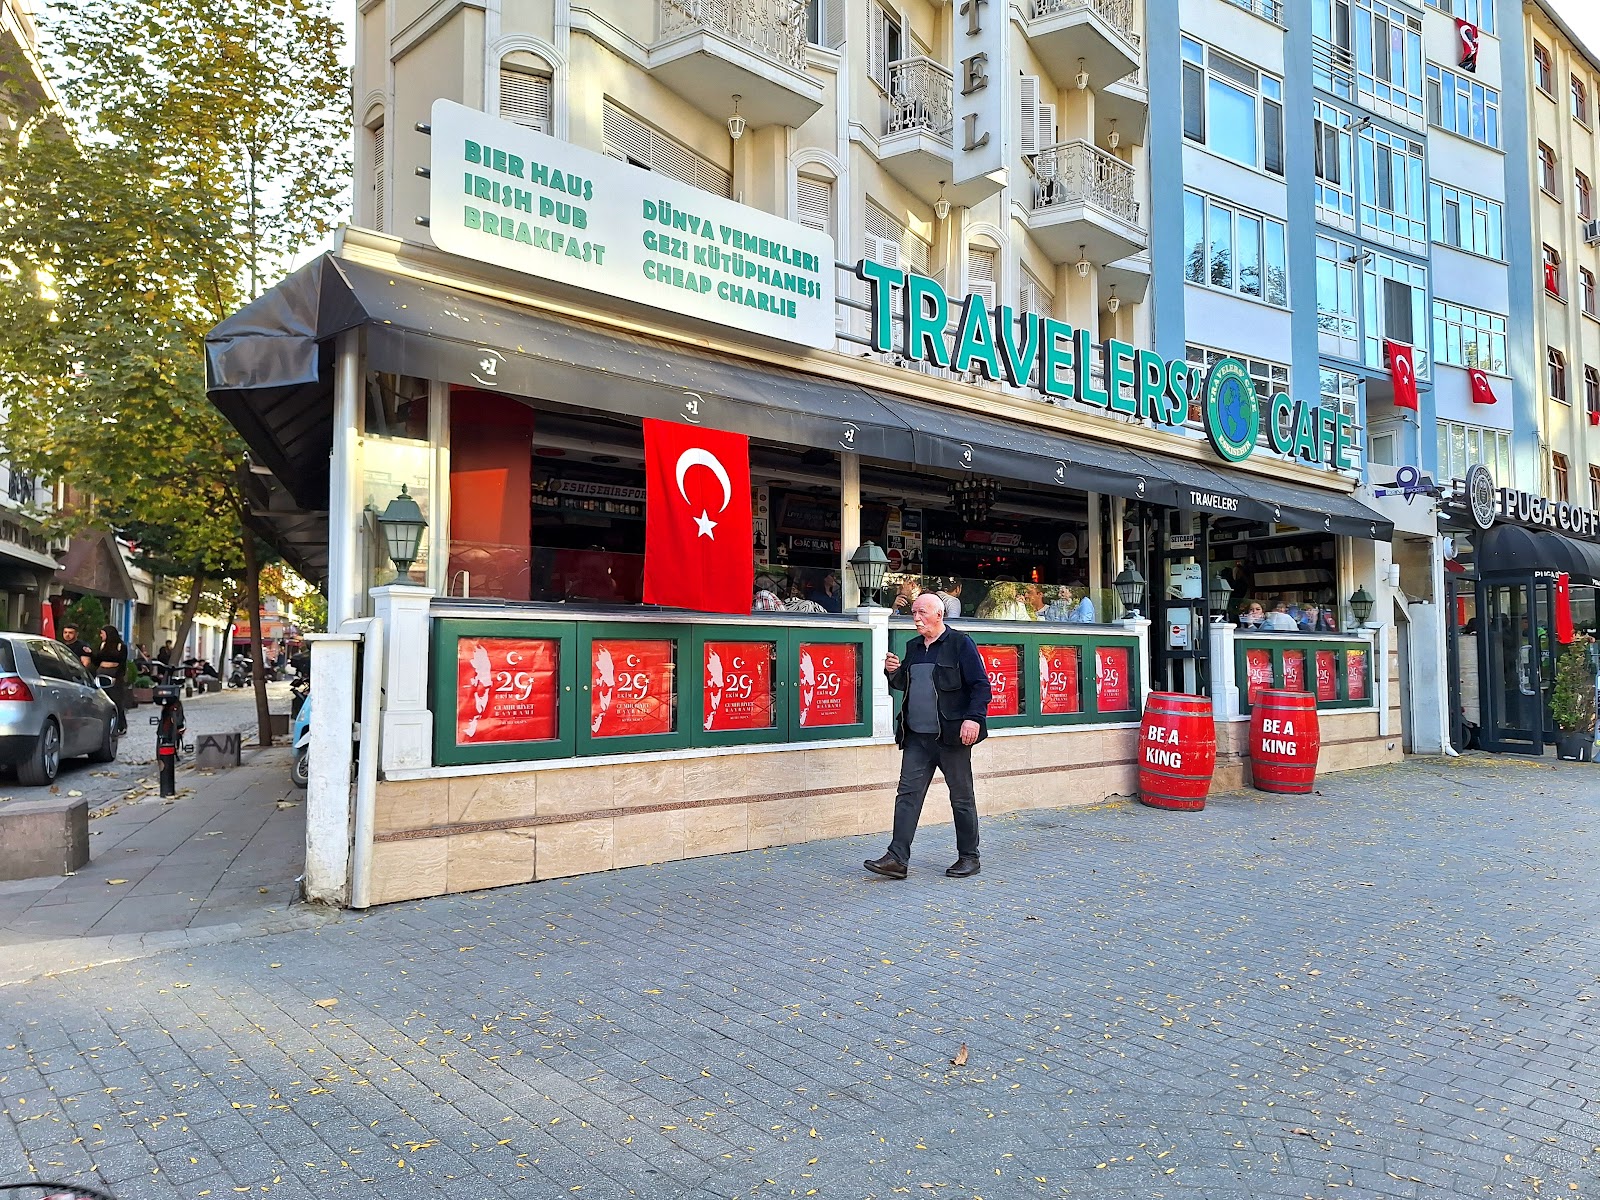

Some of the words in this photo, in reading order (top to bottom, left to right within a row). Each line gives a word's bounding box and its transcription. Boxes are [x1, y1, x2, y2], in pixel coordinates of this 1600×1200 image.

[464, 139, 525, 179] BIER
[531, 161, 593, 201] HAUS
[464, 172, 532, 214] IRISH
[539, 196, 588, 230] PUB
[642, 199, 715, 241] DÜNYA
[464, 205, 606, 266] BREAKFAST
[642, 259, 712, 295] CHEAP
[716, 281, 797, 320] CHARLIE
[858, 259, 1200, 427] TRAVELERS'
[1267, 391, 1352, 471] CAFE
[1189, 490, 1239, 512] TRAVELERS'
[1501, 488, 1557, 527] PUGA
[1558, 500, 1600, 536] COFF
[495, 671, 535, 701] 29
[617, 672, 650, 700] 29
[725, 673, 754, 699] 29
[816, 672, 841, 697] 29
[1049, 671, 1067, 692] 29
[1104, 668, 1119, 687] 29
[1147, 725, 1167, 743] BE
[1168, 729, 1179, 746] A
[1262, 718, 1282, 735] BE
[1283, 721, 1294, 736] A
[1146, 747, 1182, 769] KING
[1262, 739, 1297, 756] KING
